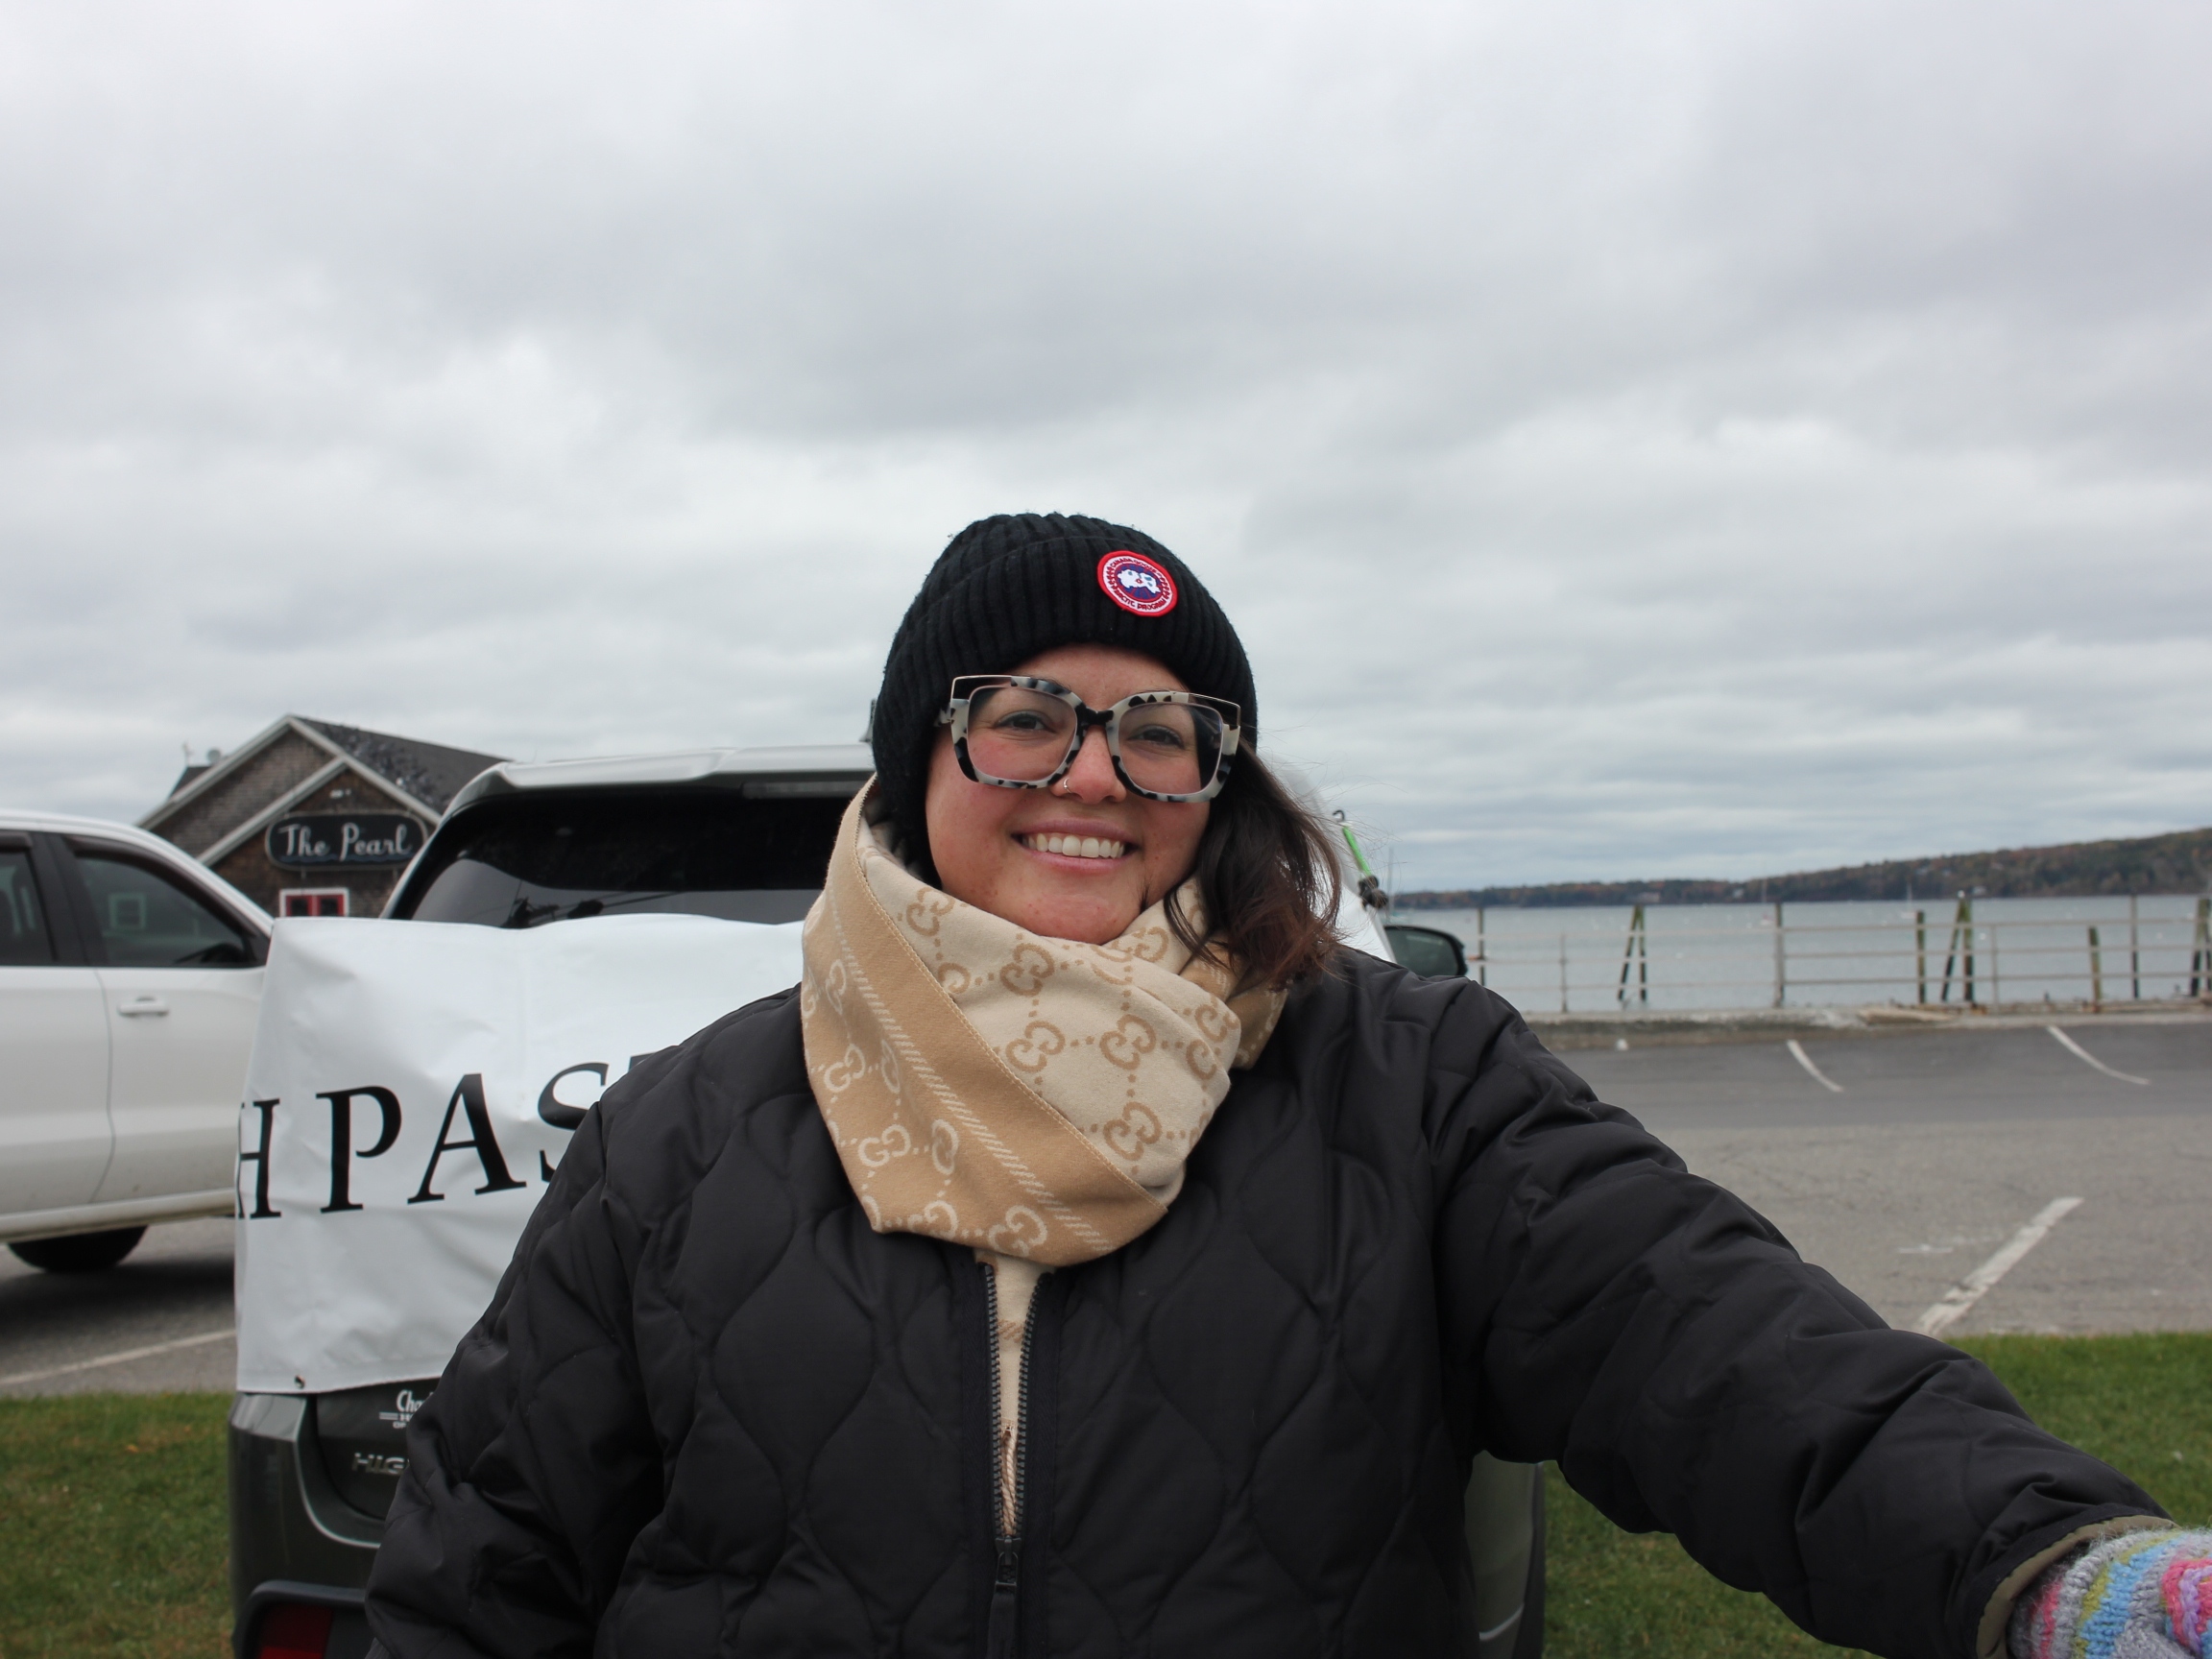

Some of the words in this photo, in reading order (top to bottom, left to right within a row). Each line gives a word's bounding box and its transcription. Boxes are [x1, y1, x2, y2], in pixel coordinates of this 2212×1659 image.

[277, 823, 329, 857] The
[340, 822, 413, 862] Pearl
[315, 1054, 657, 1214] PAS
[351, 1452, 410, 1476] HIG
